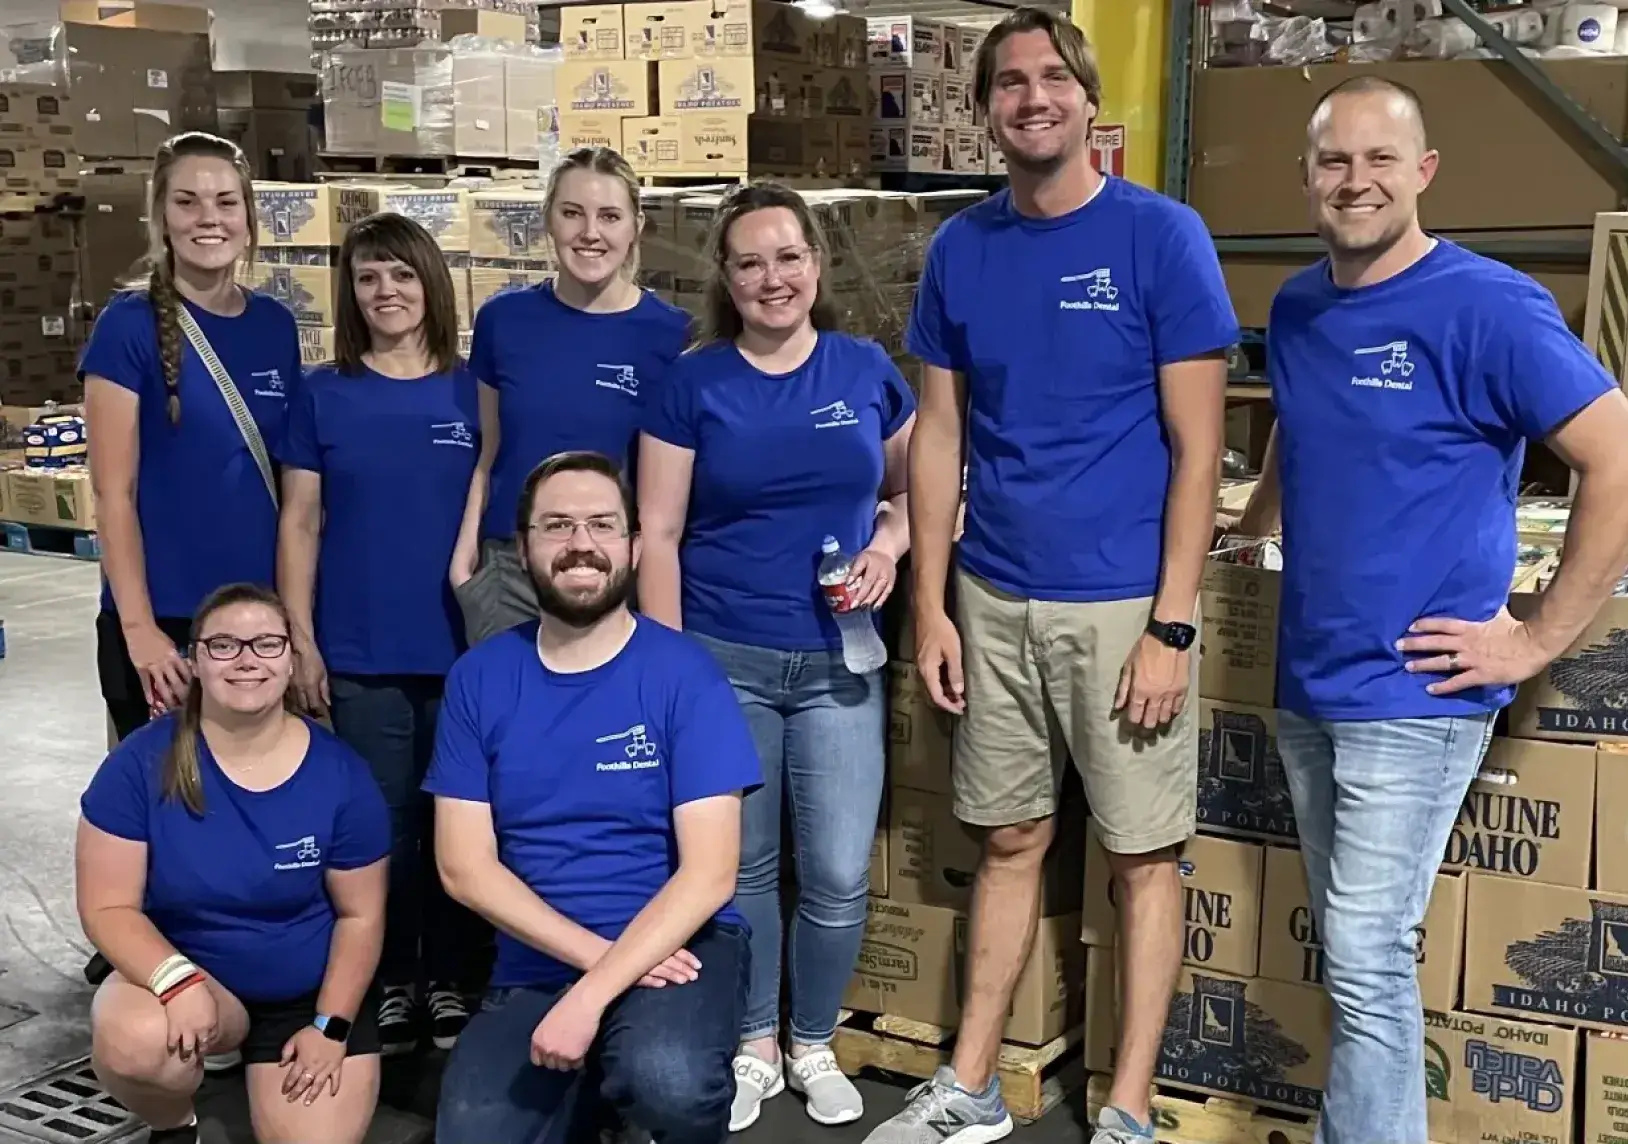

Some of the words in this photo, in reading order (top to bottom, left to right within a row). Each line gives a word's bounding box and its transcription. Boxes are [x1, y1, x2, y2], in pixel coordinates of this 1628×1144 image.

[1096, 134, 1119, 146] FIRE
[1351, 376, 1383, 388] Foothills
[1384, 379, 1413, 391] Dental
[596, 762, 632, 772] Foothills
[632, 758, 660, 769] Dental
[1508, 992, 1587, 1015] IDAHO
[1496, 1026, 1549, 1046] IDAHO
[1464, 1038, 1564, 1084] Valley
[1202, 1073, 1318, 1107] POTATOES
[1472, 1070, 1563, 1113] Circle
